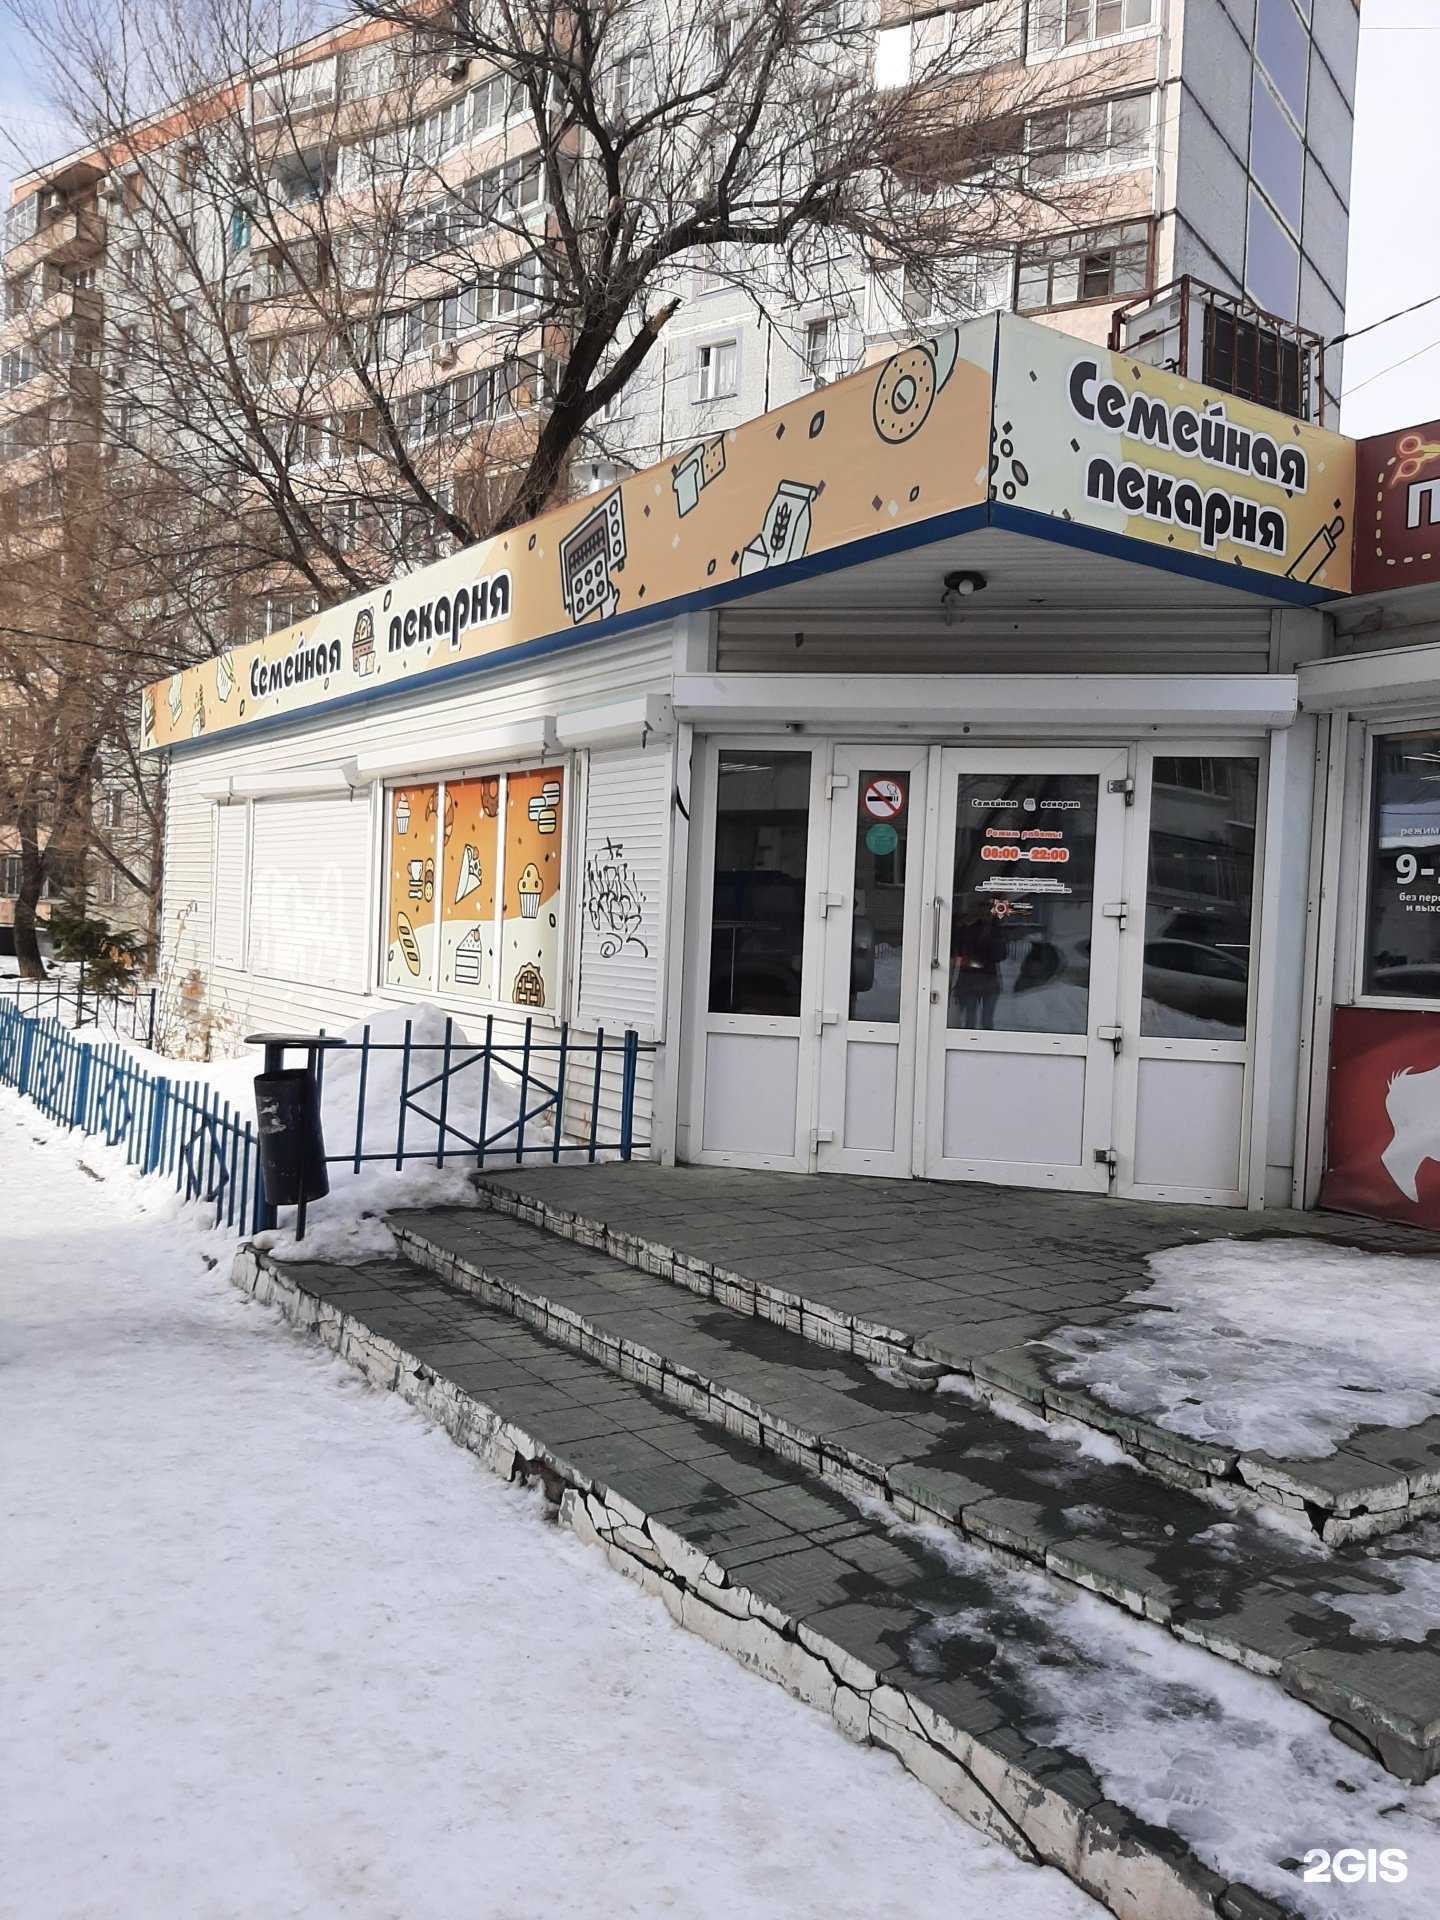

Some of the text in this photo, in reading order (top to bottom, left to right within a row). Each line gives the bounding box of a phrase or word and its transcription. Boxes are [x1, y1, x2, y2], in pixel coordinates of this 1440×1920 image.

[1068, 360, 1307, 492] Семейная
[1086, 457, 1288, 554] пекарня
[250, 573, 511, 699] Семейная пекарня
[1399, 892, 1417, 902] без
